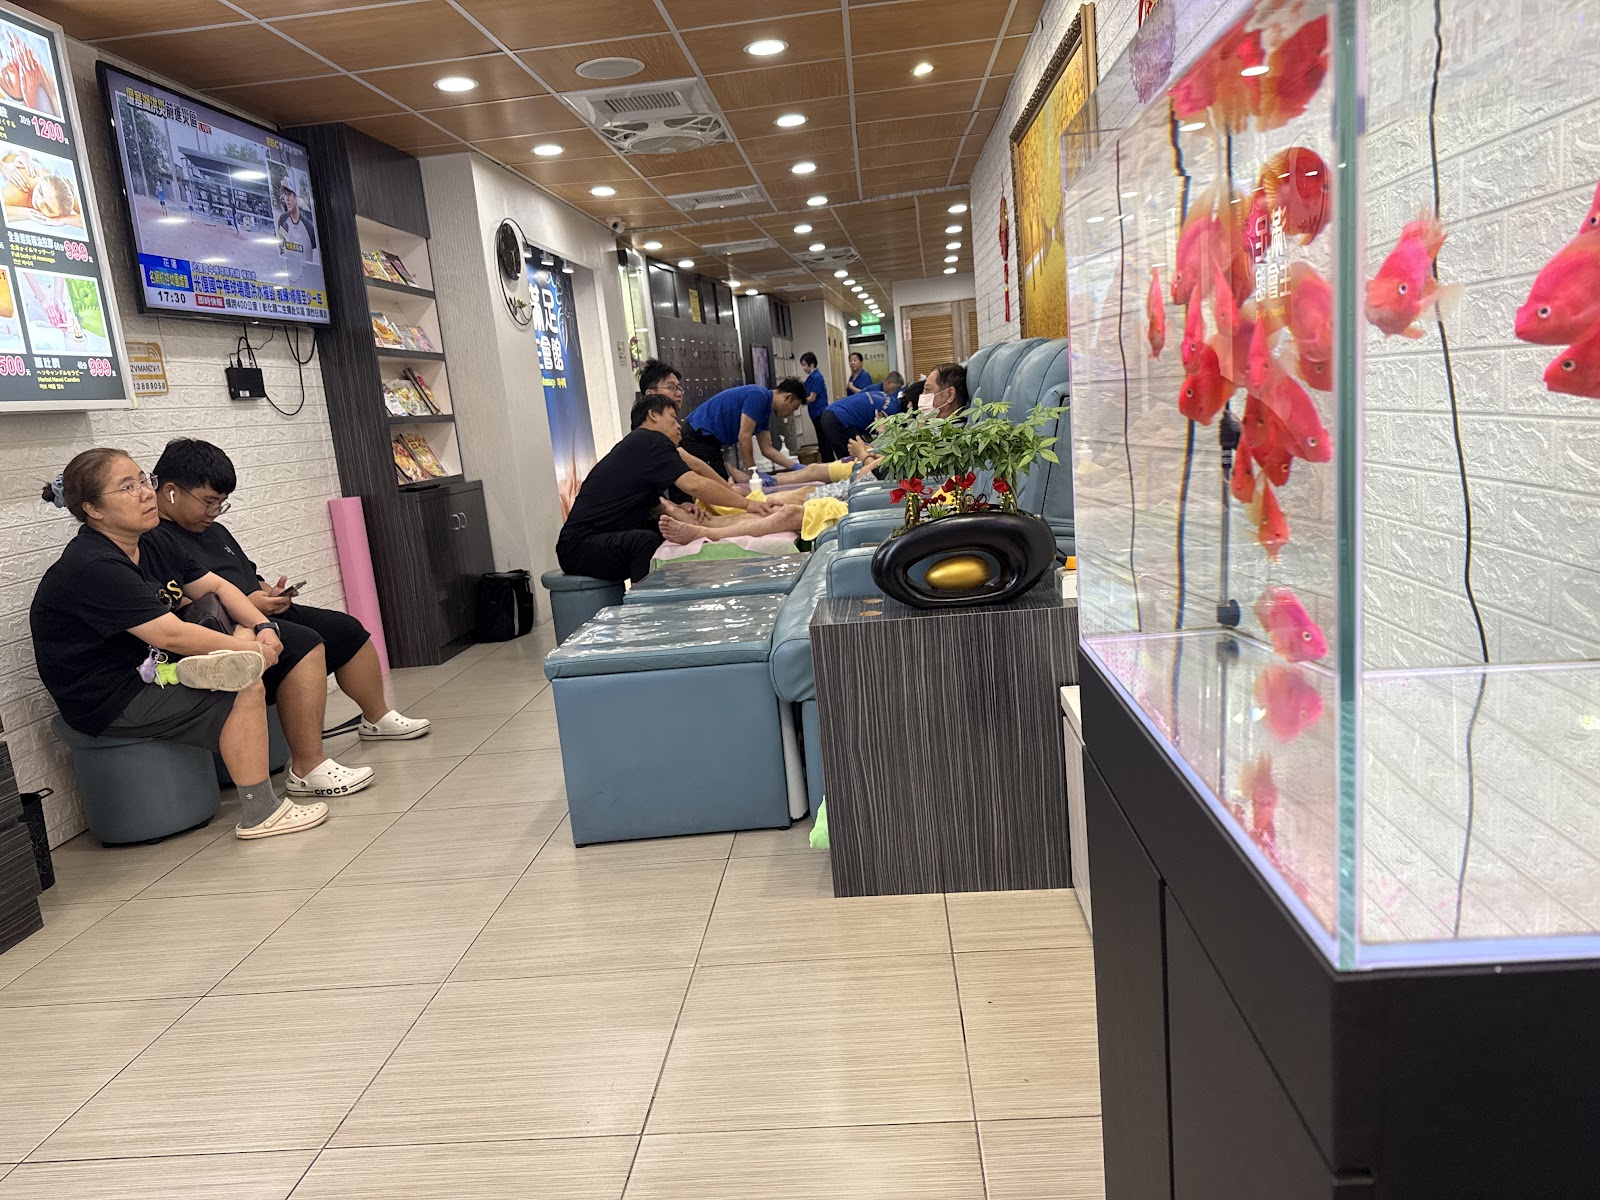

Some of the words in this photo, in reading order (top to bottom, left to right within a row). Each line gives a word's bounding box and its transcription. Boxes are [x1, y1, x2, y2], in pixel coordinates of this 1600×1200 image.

[31, 116, 64, 143] 1200
[64, 240, 88, 262] 999
[158, 291, 186, 303] 17:30
[88, 357, 112, 377] 999
[314, 785, 349, 795] crocs
